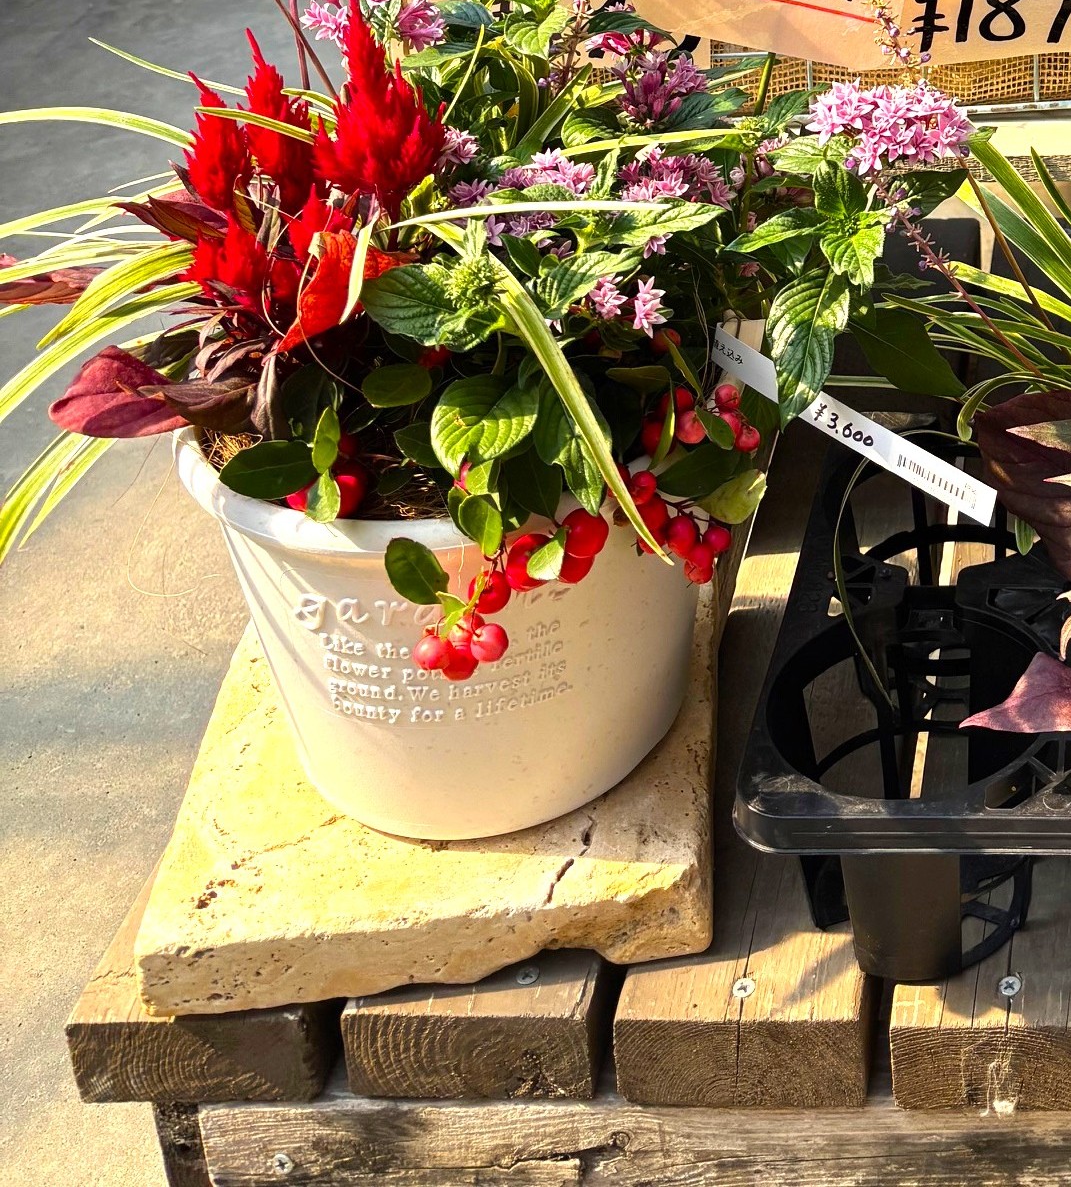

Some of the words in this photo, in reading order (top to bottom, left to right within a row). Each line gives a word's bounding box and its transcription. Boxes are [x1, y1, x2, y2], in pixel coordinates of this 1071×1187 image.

[375, 642, 411, 659] the
[323, 653, 392, 679] flower
[448, 669, 531, 701] harvest
[330, 694, 401, 724] bounty
[410, 705, 444, 723] for
[454, 707, 465, 721] a
